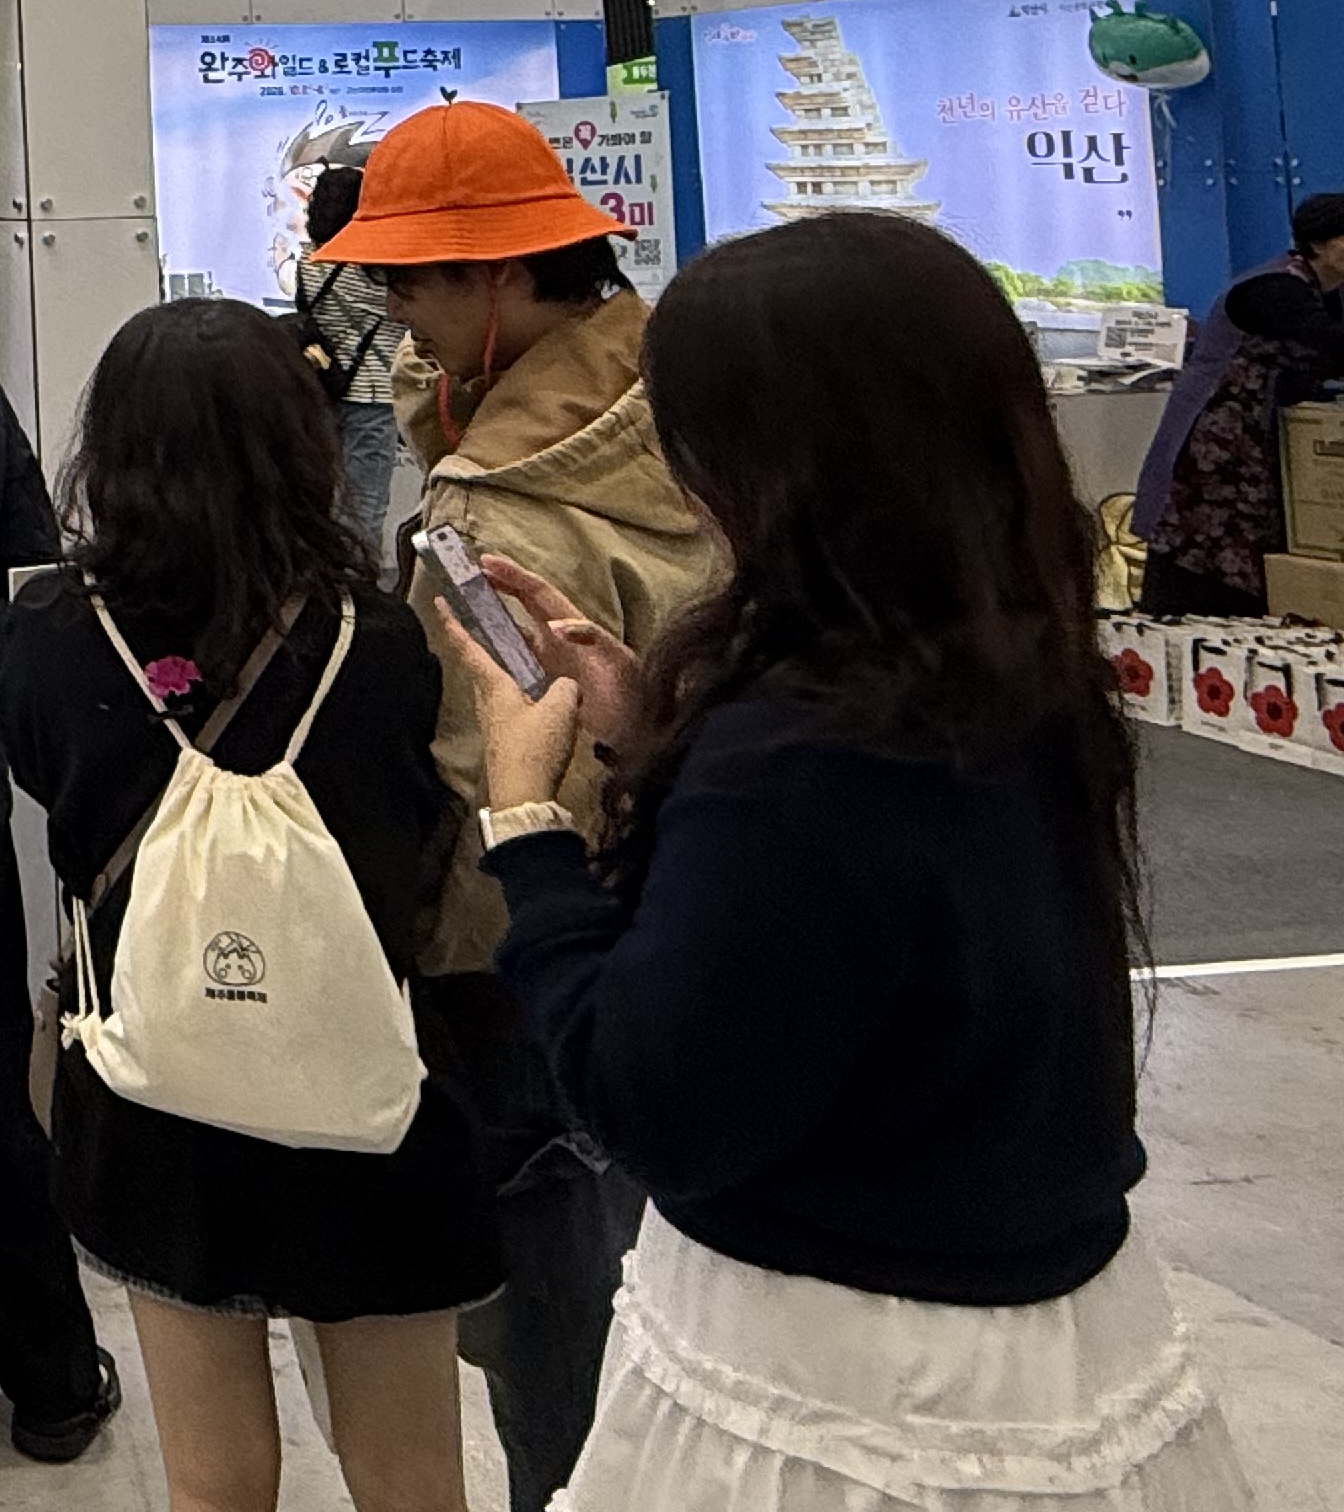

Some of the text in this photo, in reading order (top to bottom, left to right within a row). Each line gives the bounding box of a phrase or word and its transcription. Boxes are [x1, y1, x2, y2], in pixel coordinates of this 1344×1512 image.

[937, 93, 996, 124] 천년의
[1007, 92, 1069, 121] 유산을
[1027, 130, 1132, 183] 익산
